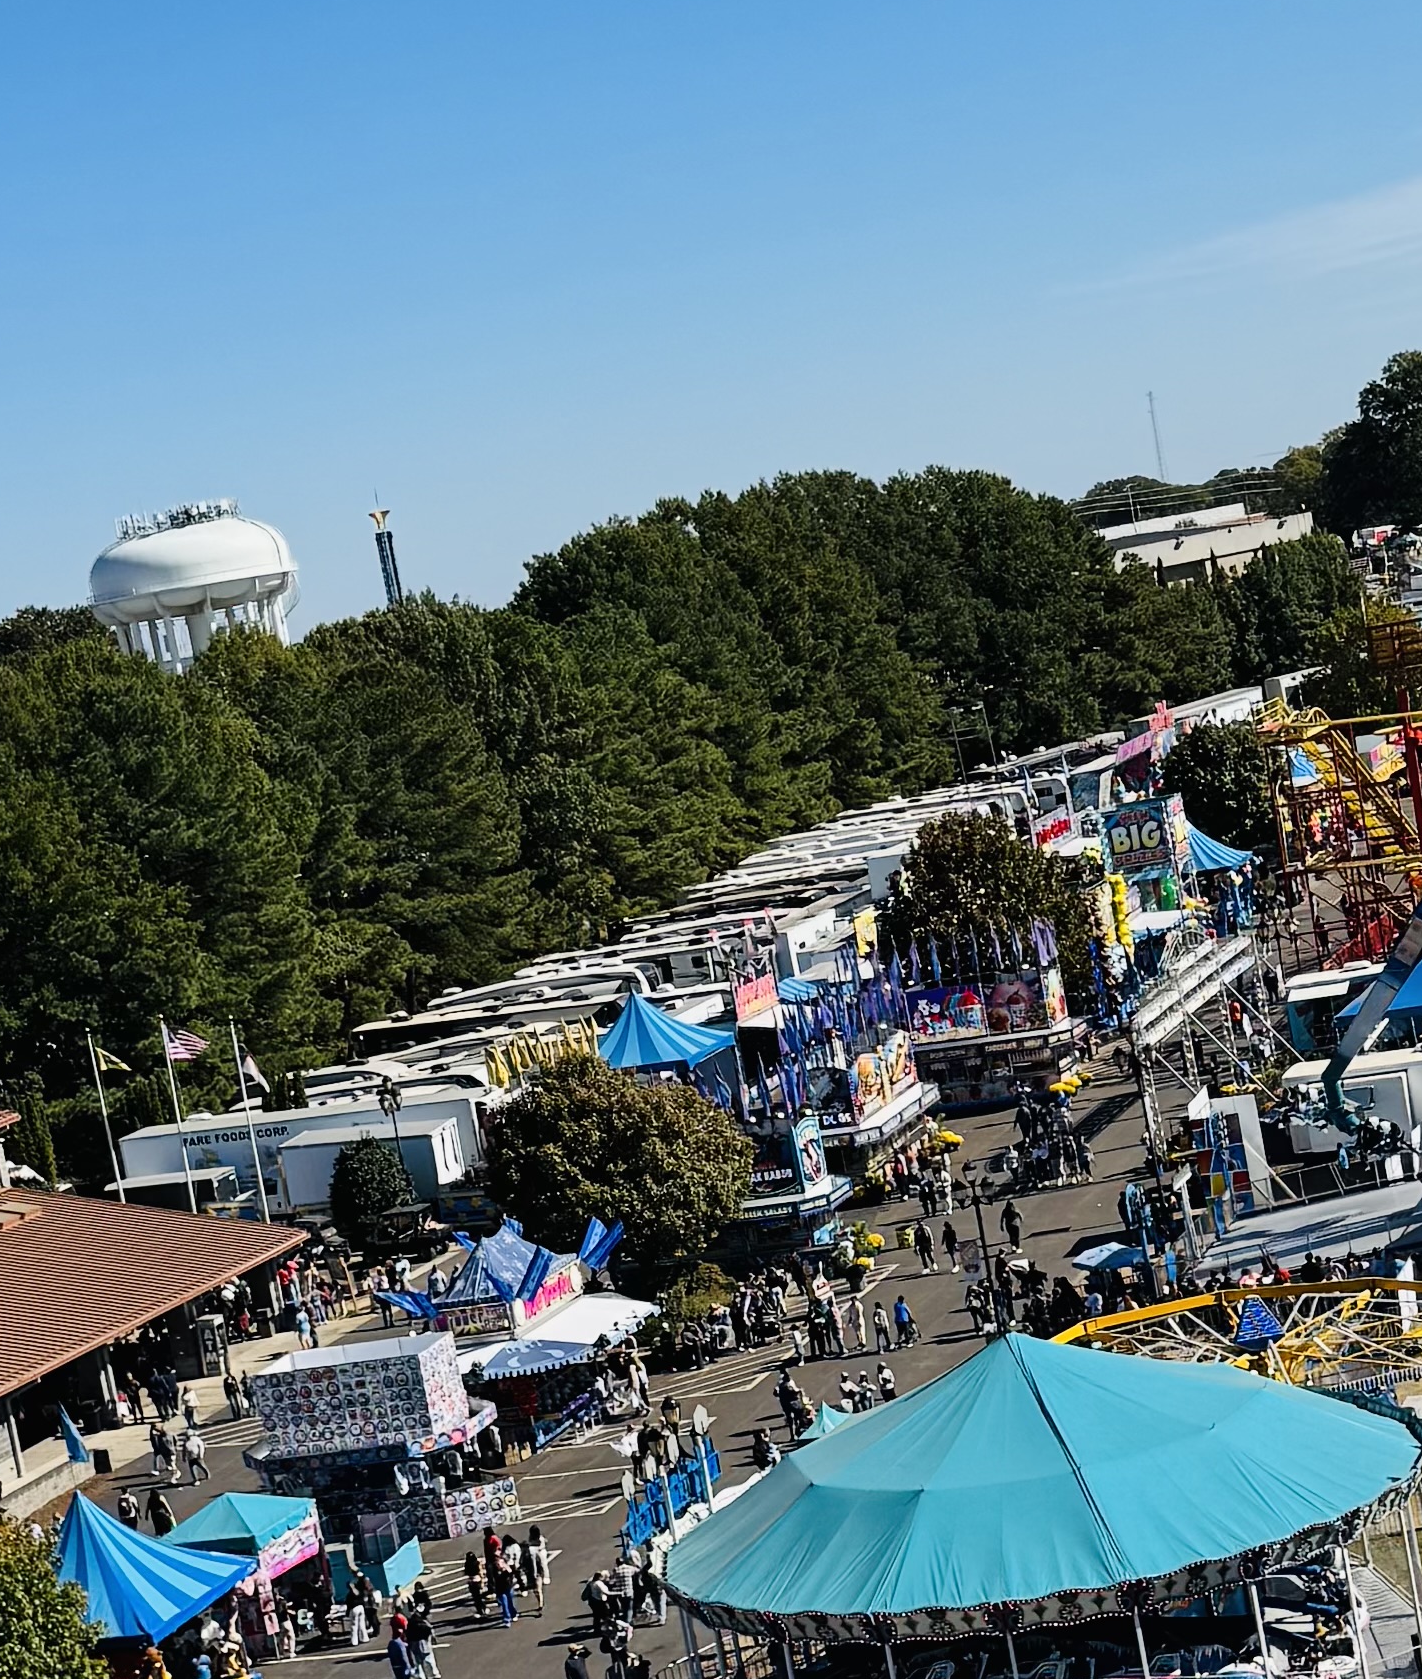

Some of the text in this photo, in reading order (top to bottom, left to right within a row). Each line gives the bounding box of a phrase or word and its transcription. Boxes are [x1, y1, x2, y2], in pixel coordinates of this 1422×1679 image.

[1111, 821, 1160, 853] BIG
[256, 1125, 290, 1139] CORP.
[204, 1329, 219, 1363] ATM
